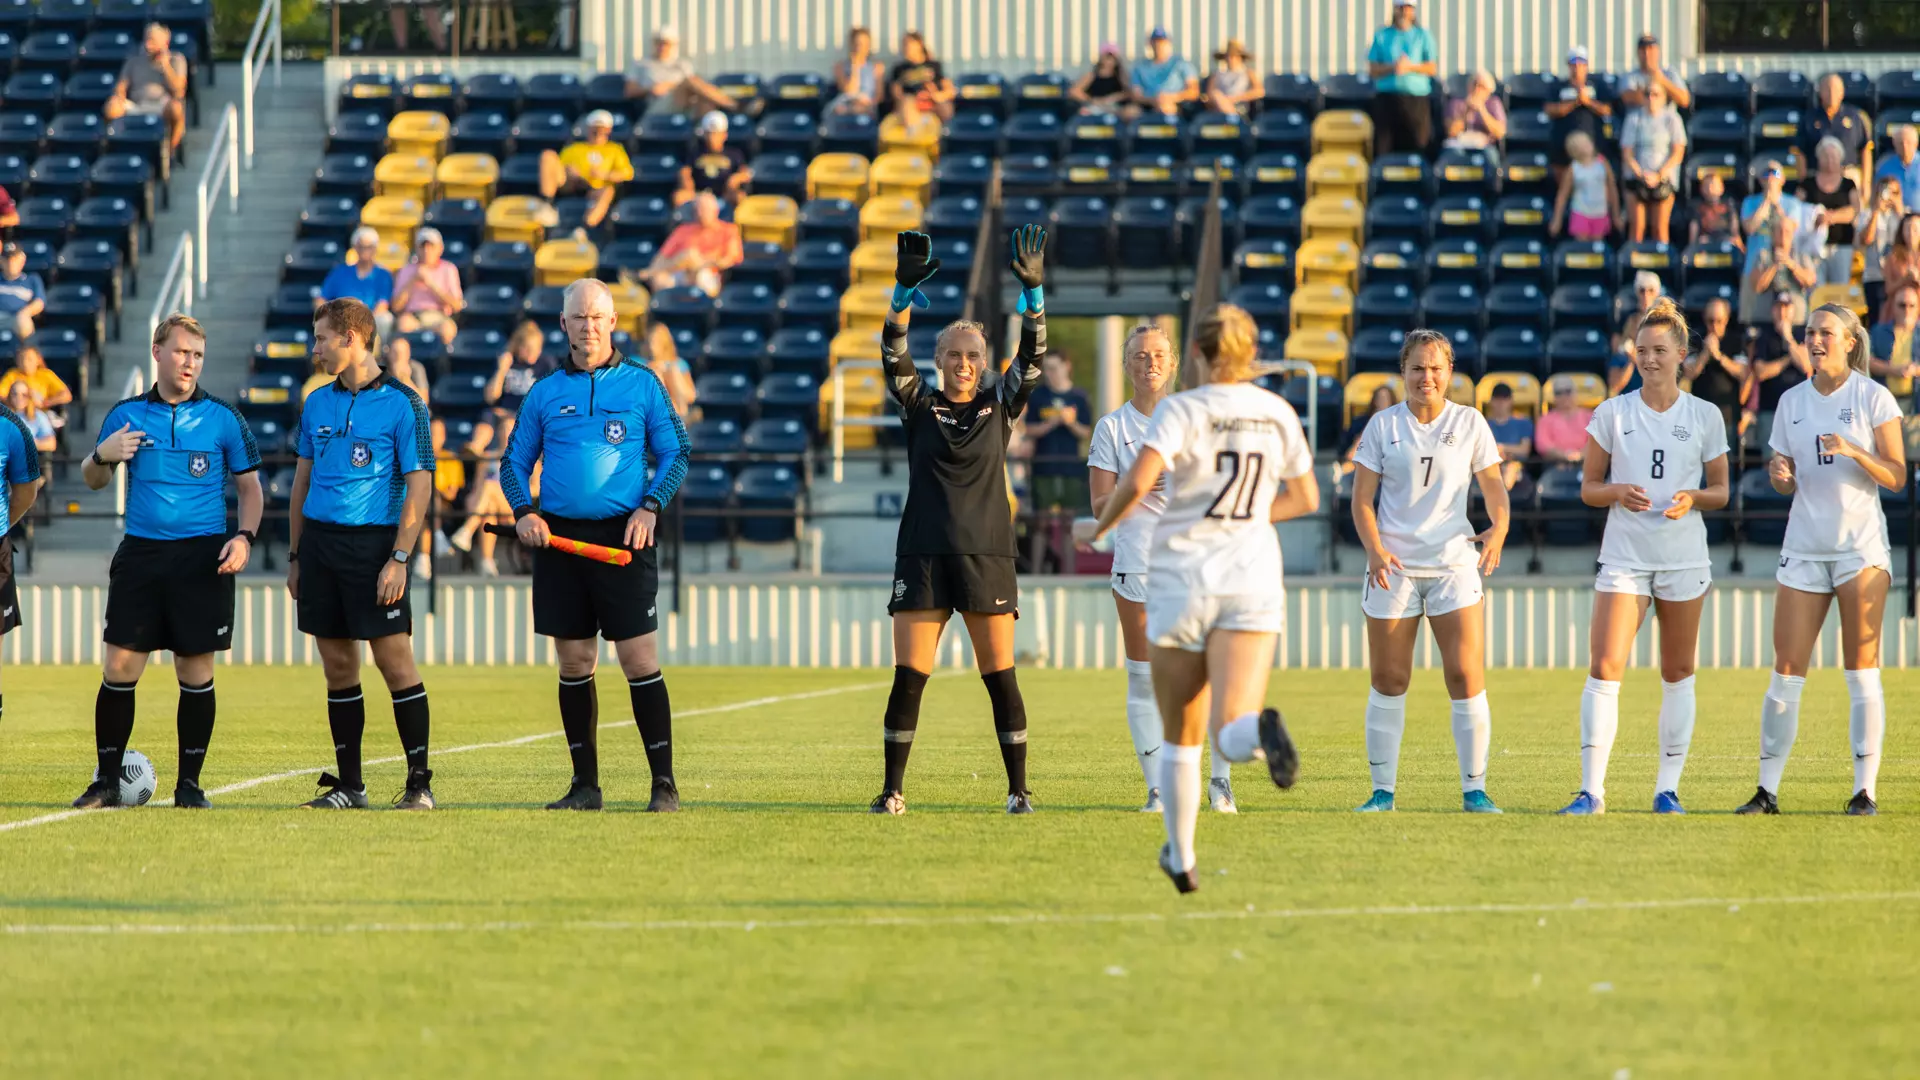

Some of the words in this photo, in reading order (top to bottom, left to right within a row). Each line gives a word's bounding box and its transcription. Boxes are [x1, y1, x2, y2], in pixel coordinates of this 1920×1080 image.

[1420, 456, 1433, 487] 7
[1651, 449, 1665, 480] 8
[1203, 450, 1263, 520] 20
